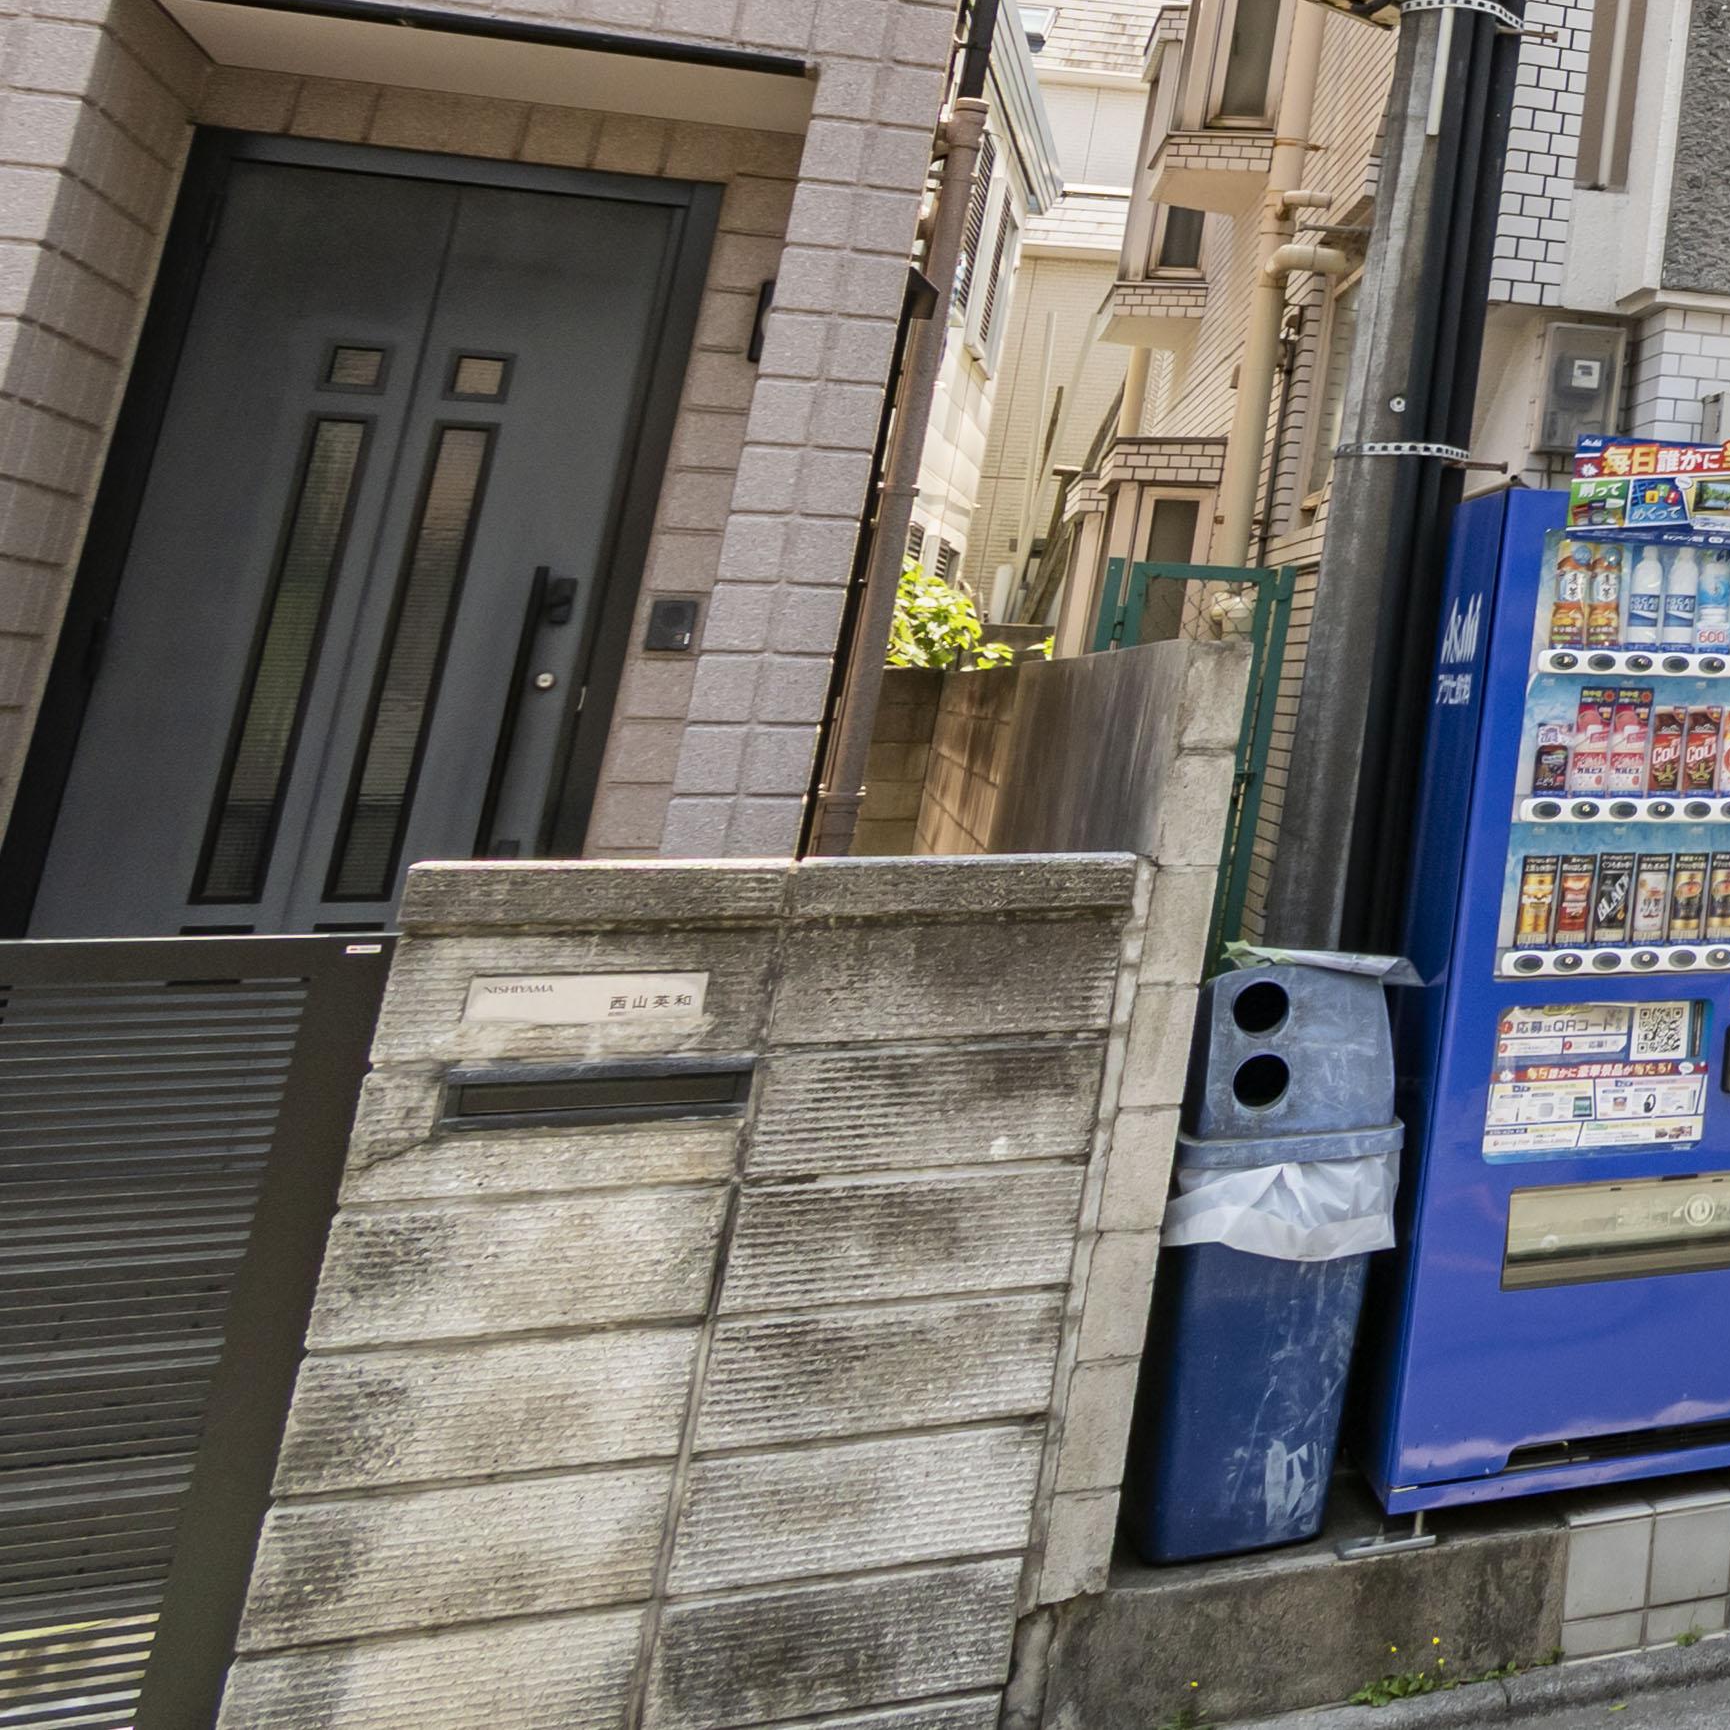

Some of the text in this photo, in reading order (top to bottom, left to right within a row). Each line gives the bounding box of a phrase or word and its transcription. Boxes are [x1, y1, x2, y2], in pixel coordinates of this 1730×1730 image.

[1631, 505, 1682, 521] めくって
[609, 993, 693, 1011] 西山英和
